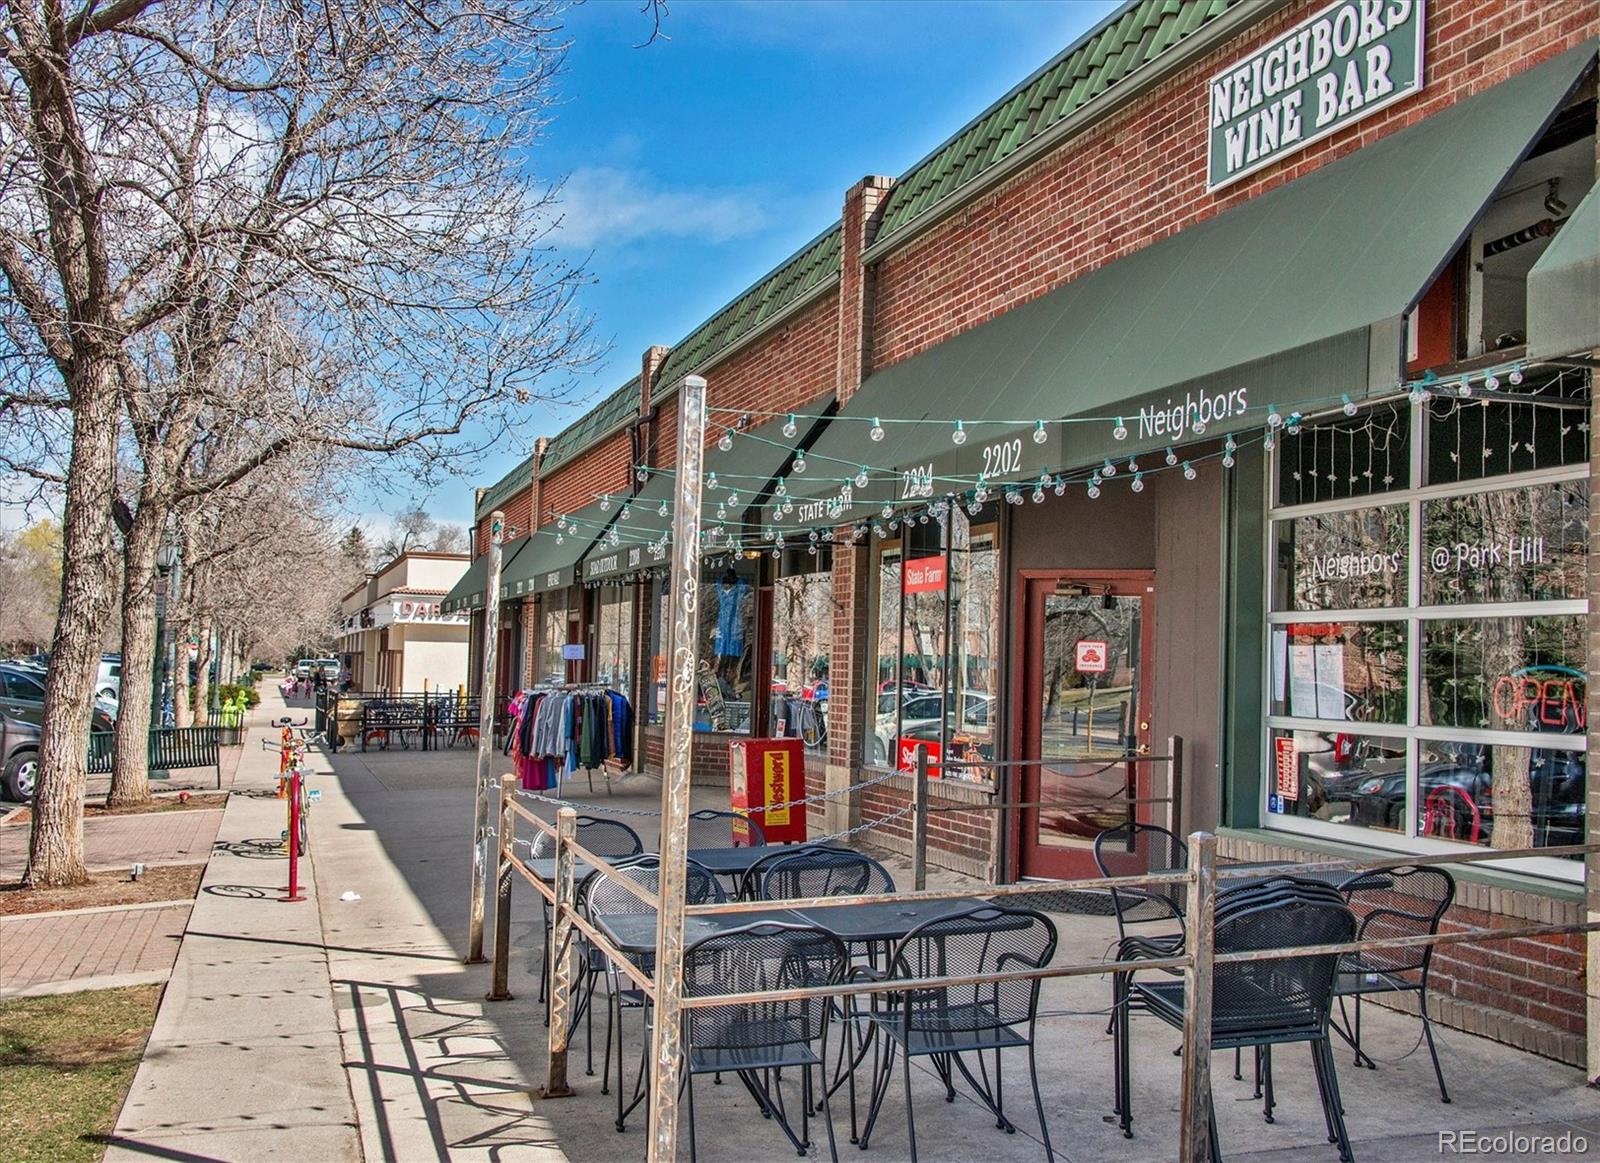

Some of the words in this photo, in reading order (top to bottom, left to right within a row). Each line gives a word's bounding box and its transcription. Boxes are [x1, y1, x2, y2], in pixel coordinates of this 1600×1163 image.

[1213, 0, 1411, 128] NEIGHBORS
[1225, 90, 1302, 173] WINE
[1316, 45, 1393, 128] BAR
[1139, 387, 1247, 441] Neighbors
[982, 438, 1022, 479] 2202
[799, 500, 823, 523] STATE
[907, 568, 924, 586] State
[924, 566, 943, 584] Farm
[1312, 551, 1400, 580] Neighbors
[1431, 546, 1450, 573] @
[1455, 542, 1501, 571] Park
[1508, 536, 1544, 567] Hill
[1494, 675, 1588, 729] OPEN
